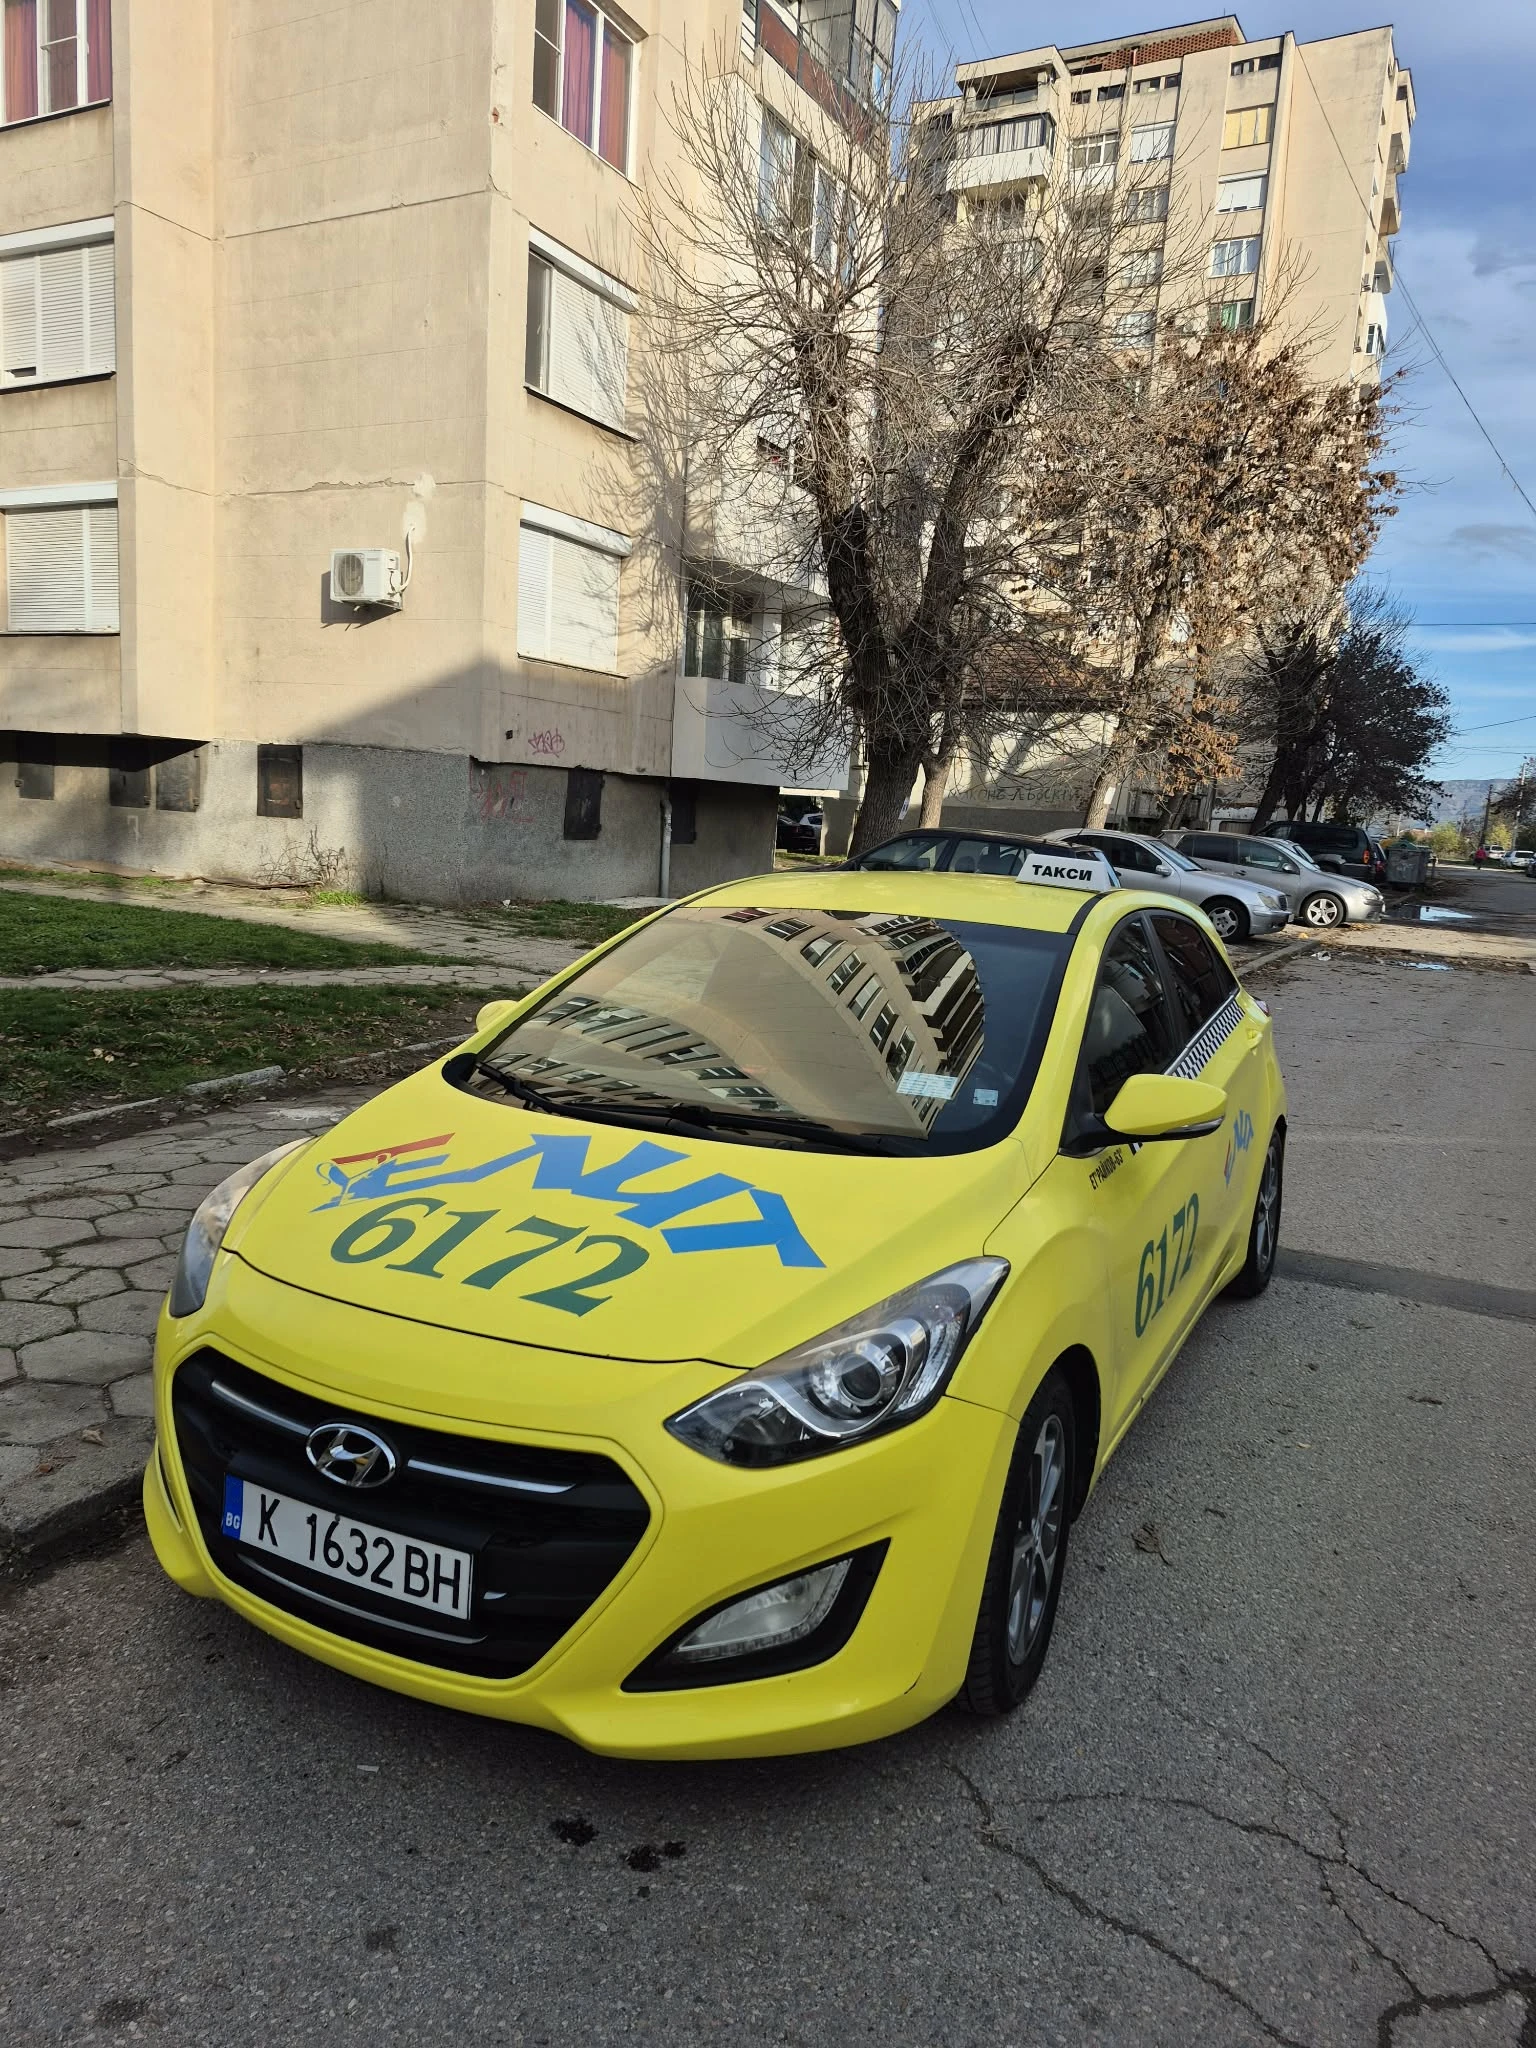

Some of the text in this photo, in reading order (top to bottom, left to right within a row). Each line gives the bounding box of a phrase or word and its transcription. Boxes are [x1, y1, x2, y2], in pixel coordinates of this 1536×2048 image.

[1032, 864, 1093, 881] ТАКСИ
[330, 1197, 650, 1317] 6172
[1135, 1193, 1199, 1338] 6172
[225, 1511, 241, 1530] BG
